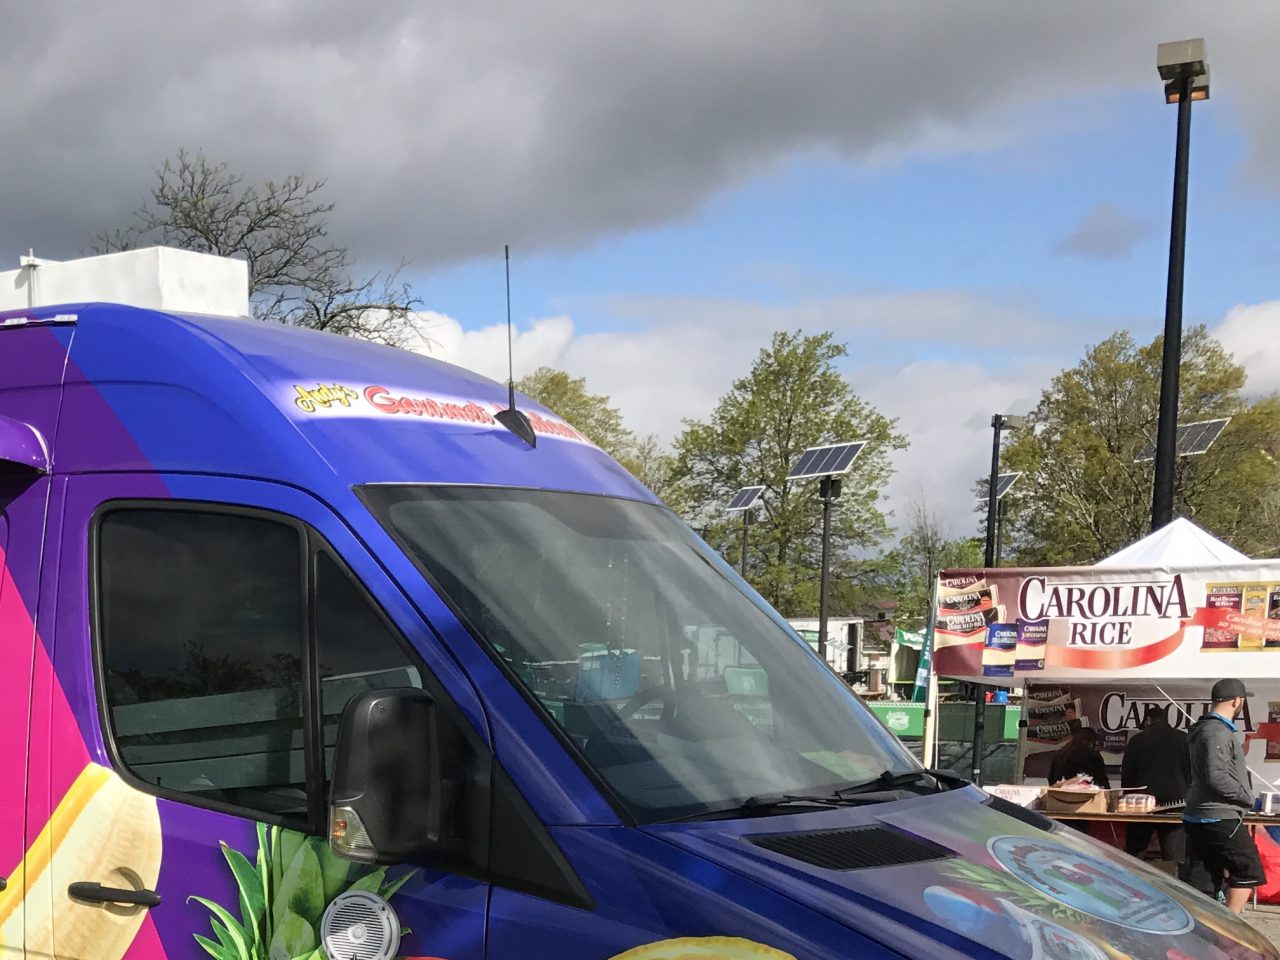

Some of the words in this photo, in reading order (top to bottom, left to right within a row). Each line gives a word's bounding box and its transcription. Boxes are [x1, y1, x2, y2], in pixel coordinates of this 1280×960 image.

[293, 383, 358, 413] Andy's
[363, 385, 496, 426] Gourmet
[945, 575, 978, 587] CAROLINA
[946, 591, 982, 604] CAROLINA
[1019, 574, 1193, 620] CAROLINA
[946, 611, 985, 626] CAROLINA
[1070, 620, 1133, 647] RICE
[1100, 691, 1255, 733] CAOLA
